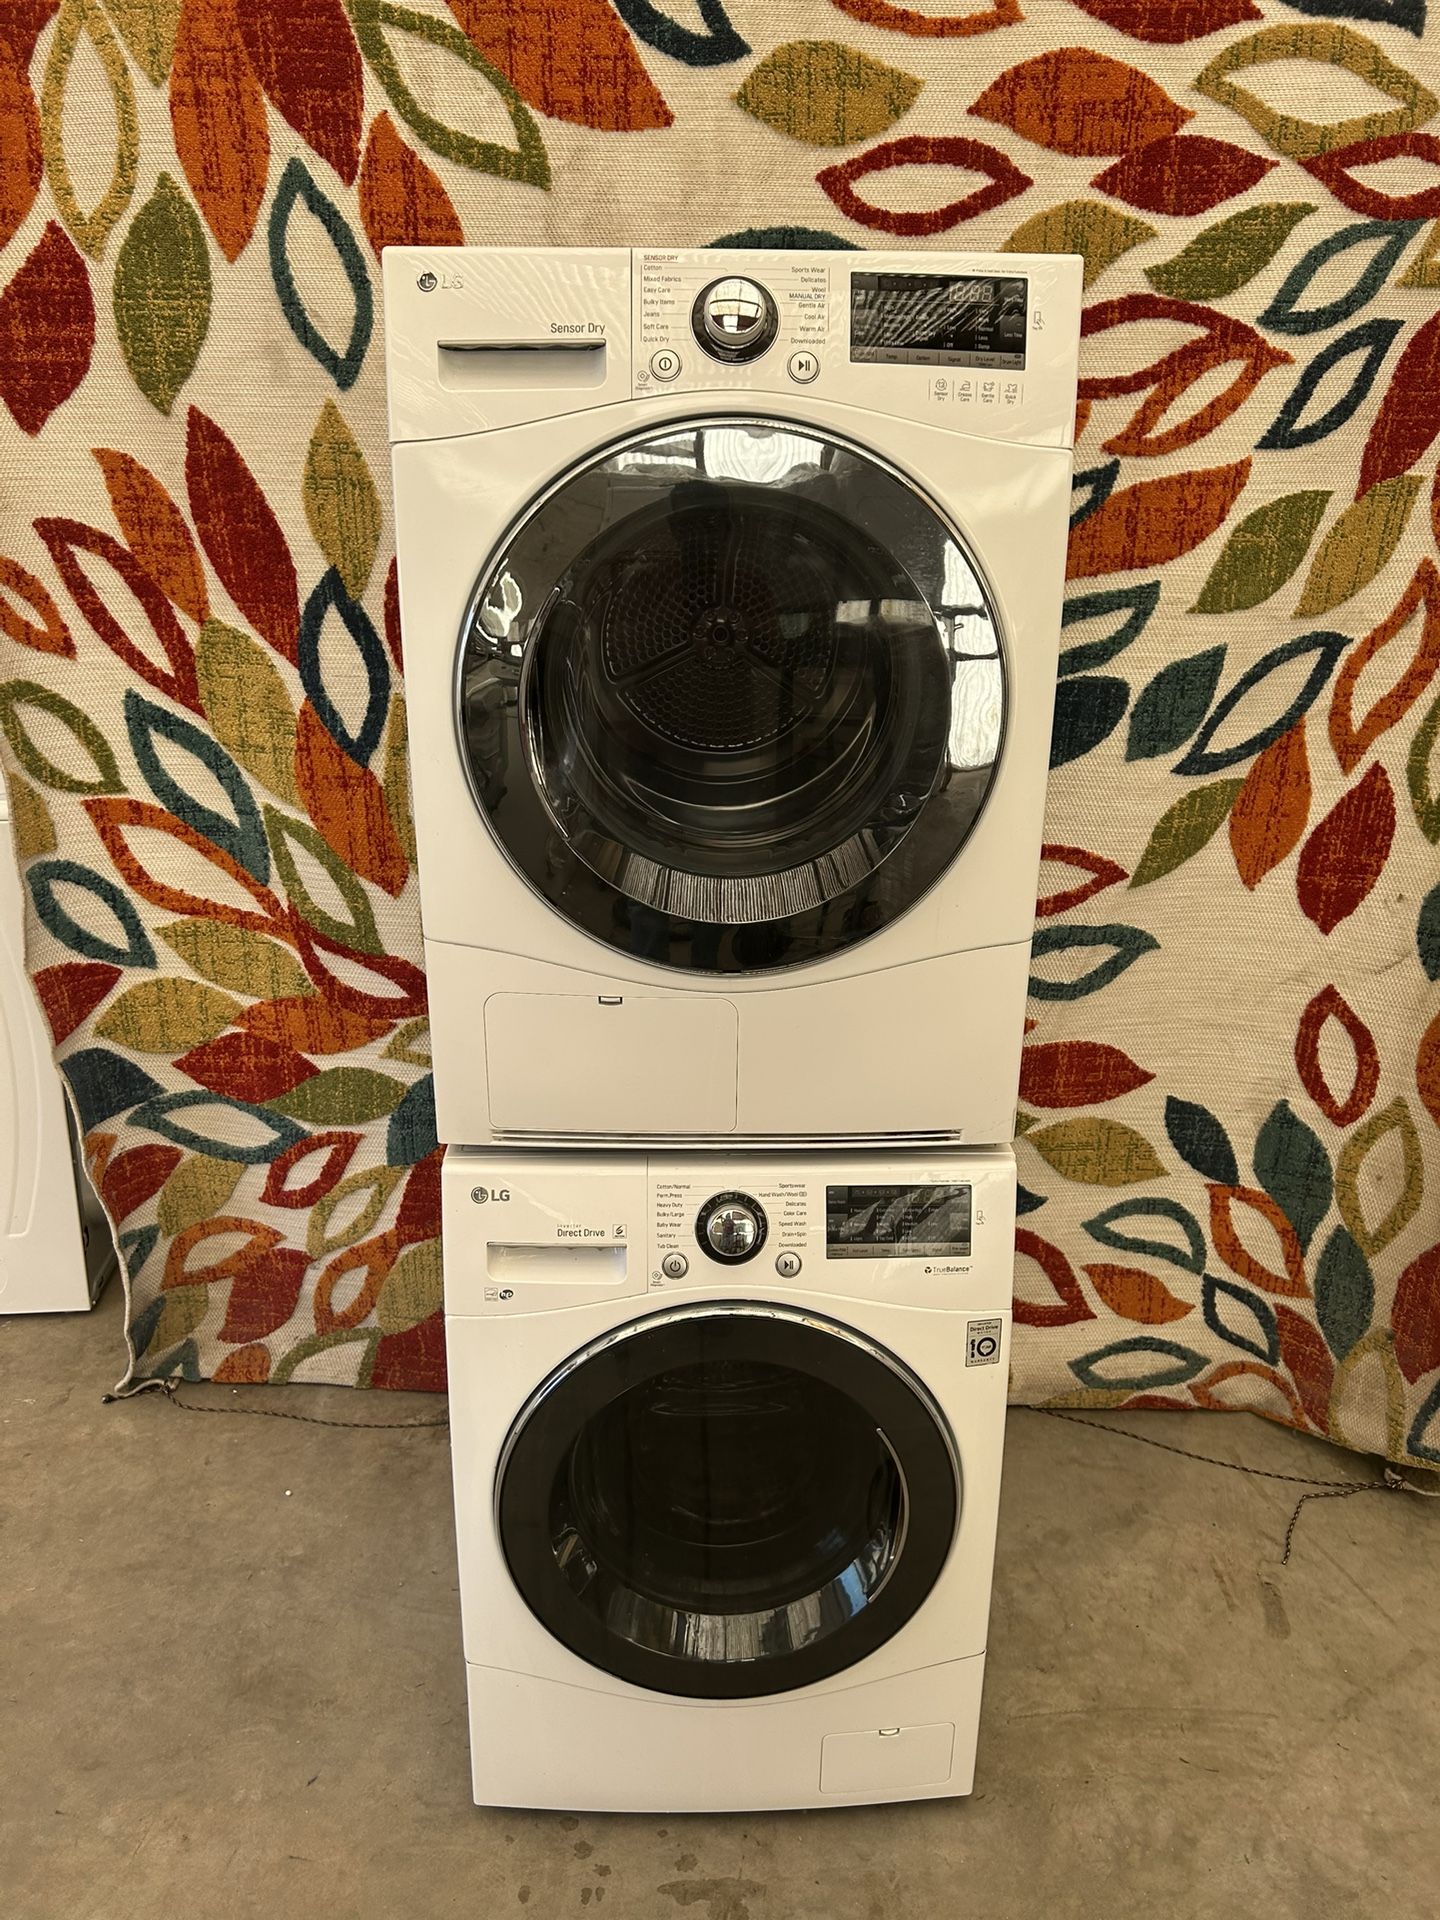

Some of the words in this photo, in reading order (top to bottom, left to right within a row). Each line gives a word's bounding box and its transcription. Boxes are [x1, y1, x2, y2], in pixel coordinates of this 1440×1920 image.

[441, 274, 464, 290] LG
[550, 322, 585, 334] Sensor
[588, 322, 606, 337] Dry
[491, 1190, 510, 1201] LG
[557, 1229, 582, 1237] Direct
[584, 1229, 605, 1237] Drive
